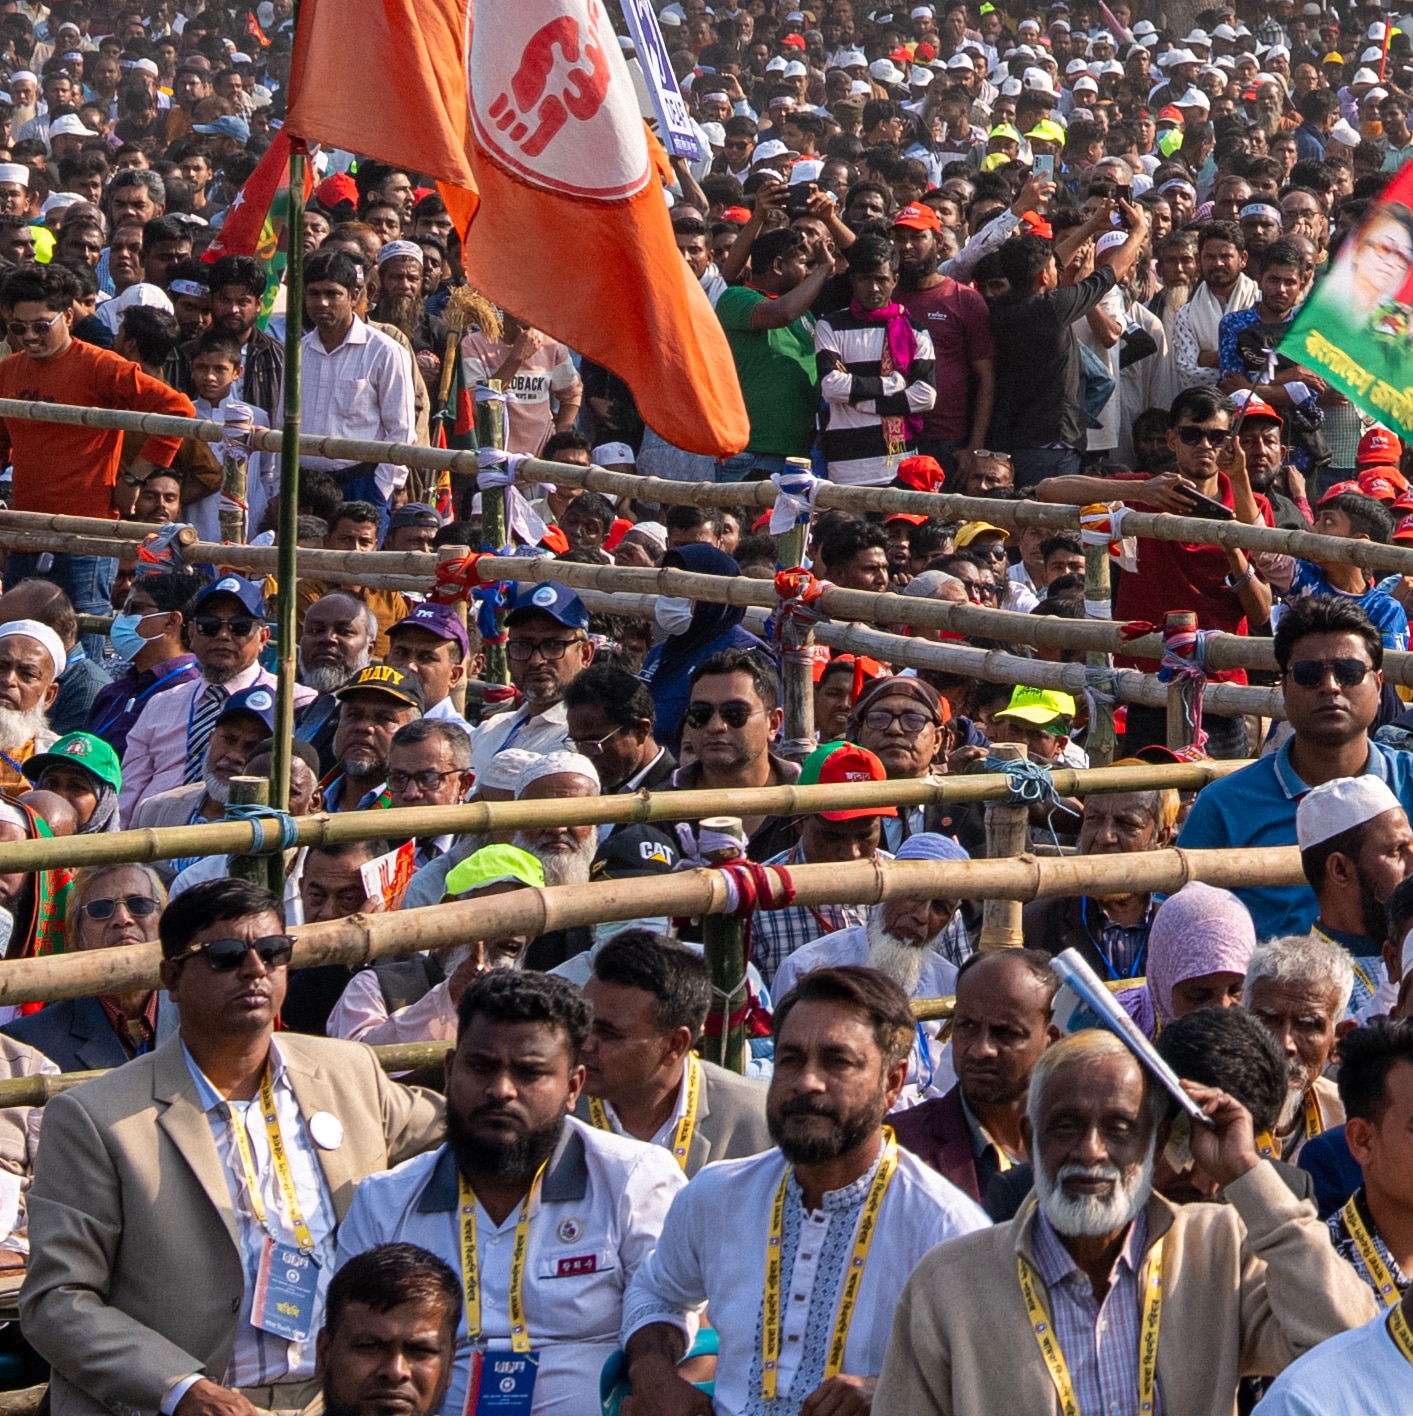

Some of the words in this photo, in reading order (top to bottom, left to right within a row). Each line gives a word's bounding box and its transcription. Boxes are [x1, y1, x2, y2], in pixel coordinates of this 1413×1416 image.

[1304, 328, 1375, 397] বাংলাদেশ
[357, 665, 405, 686] NAVY
[639, 841, 674, 866] CAT
